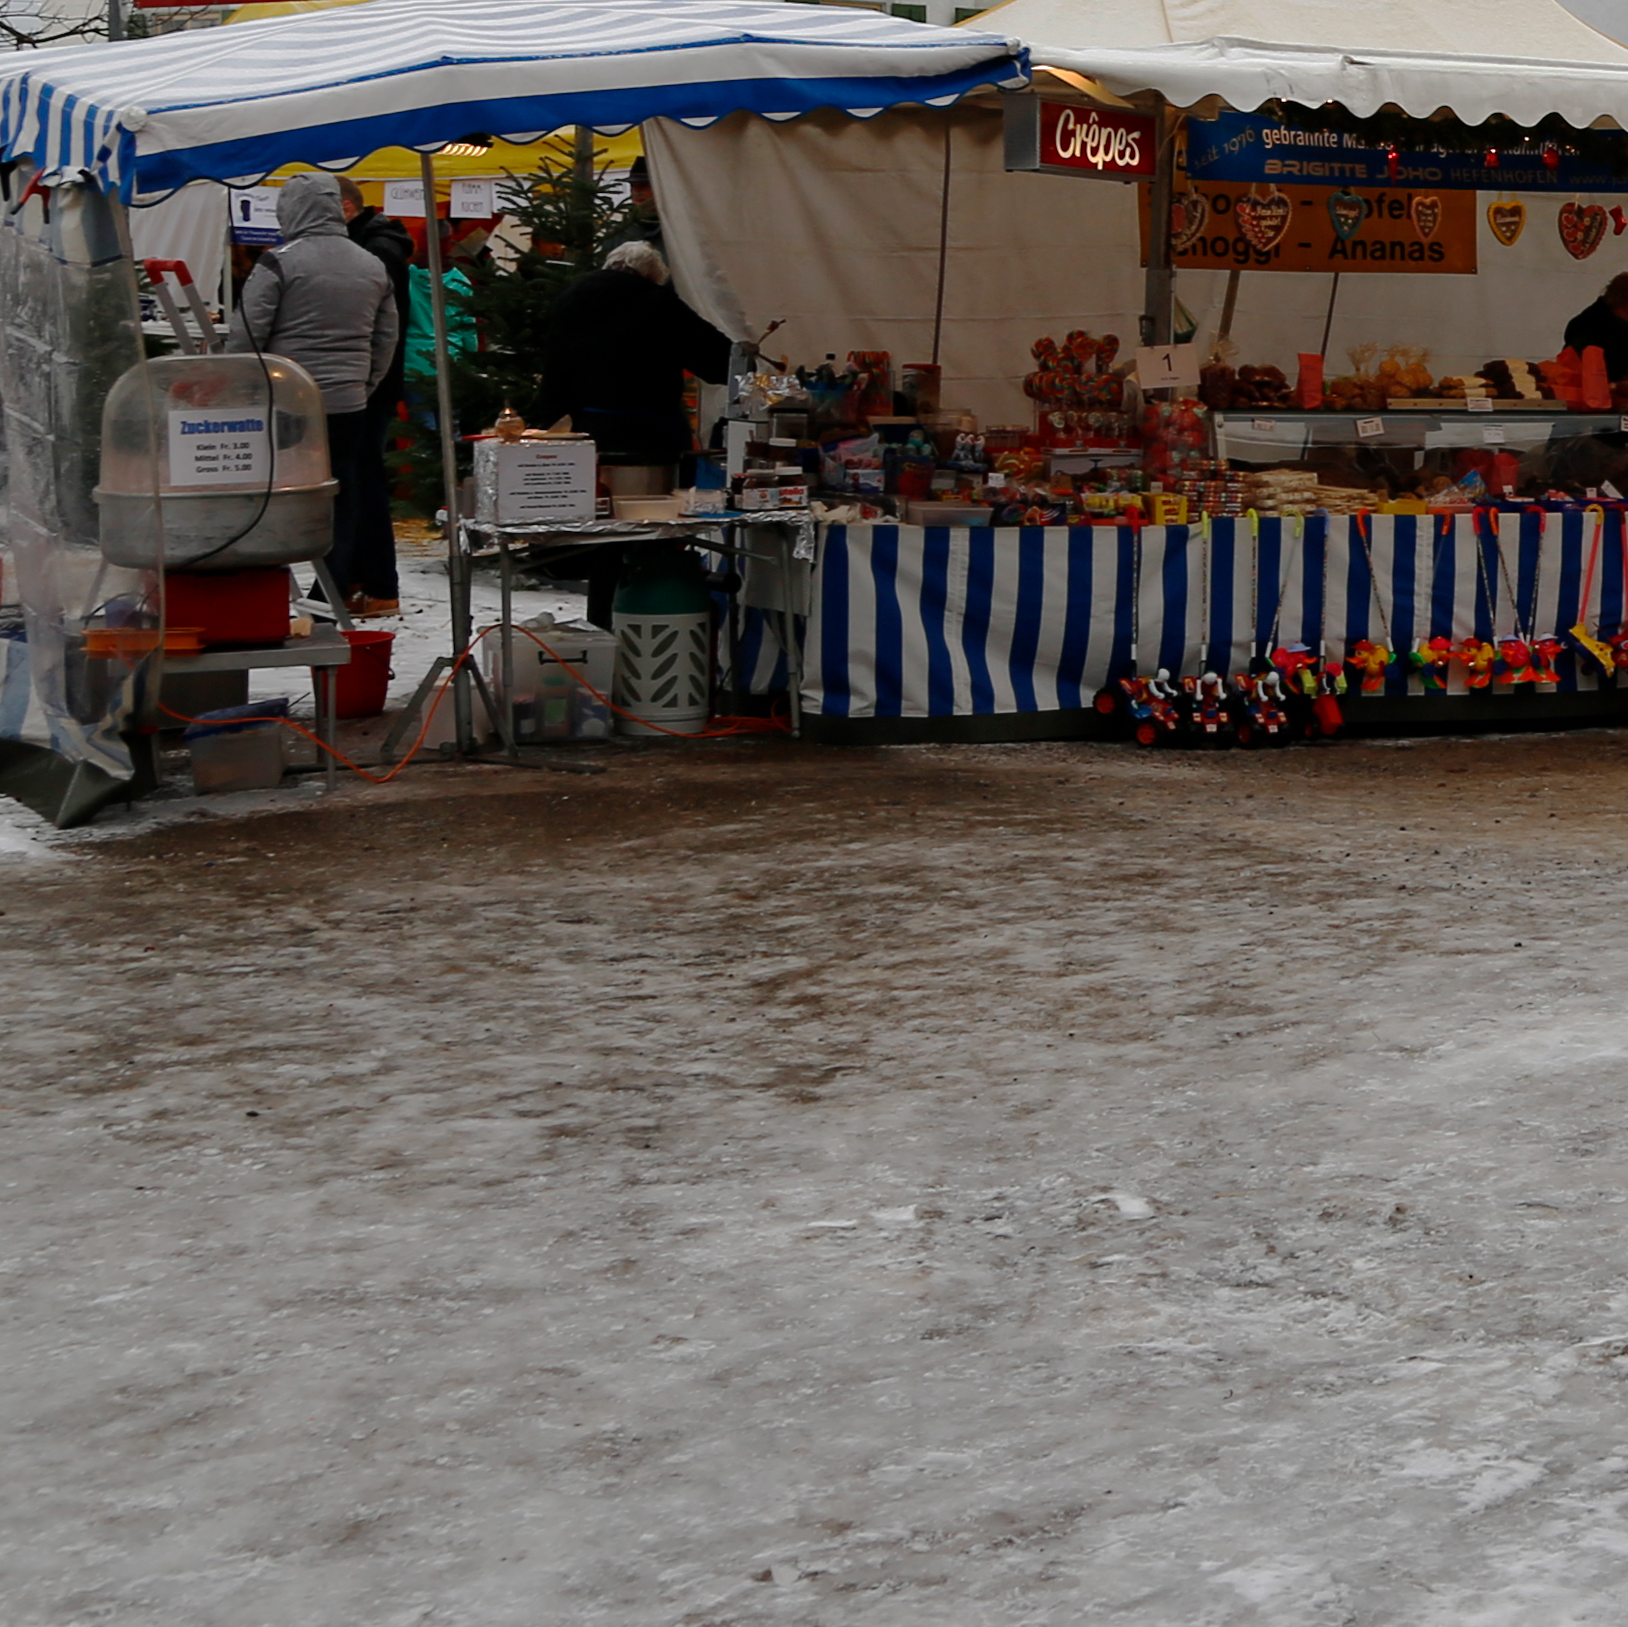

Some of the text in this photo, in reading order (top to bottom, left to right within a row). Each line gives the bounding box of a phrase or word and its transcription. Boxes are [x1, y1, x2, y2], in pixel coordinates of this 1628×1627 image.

[1055, 109, 1141, 170] Crêpes
[1222, 125, 1256, 155] 1976
[1264, 159, 1368, 179] BRIGITTE
[1375, 165, 1442, 181] JOHO
[1450, 168, 1559, 184] HEFENHOFEN
[1328, 235, 1445, 262] Ananas
[1162, 353, 1172, 372] 1
[180, 419, 264, 435] Zuckerwatte
[196, 443, 217, 451] Klein
